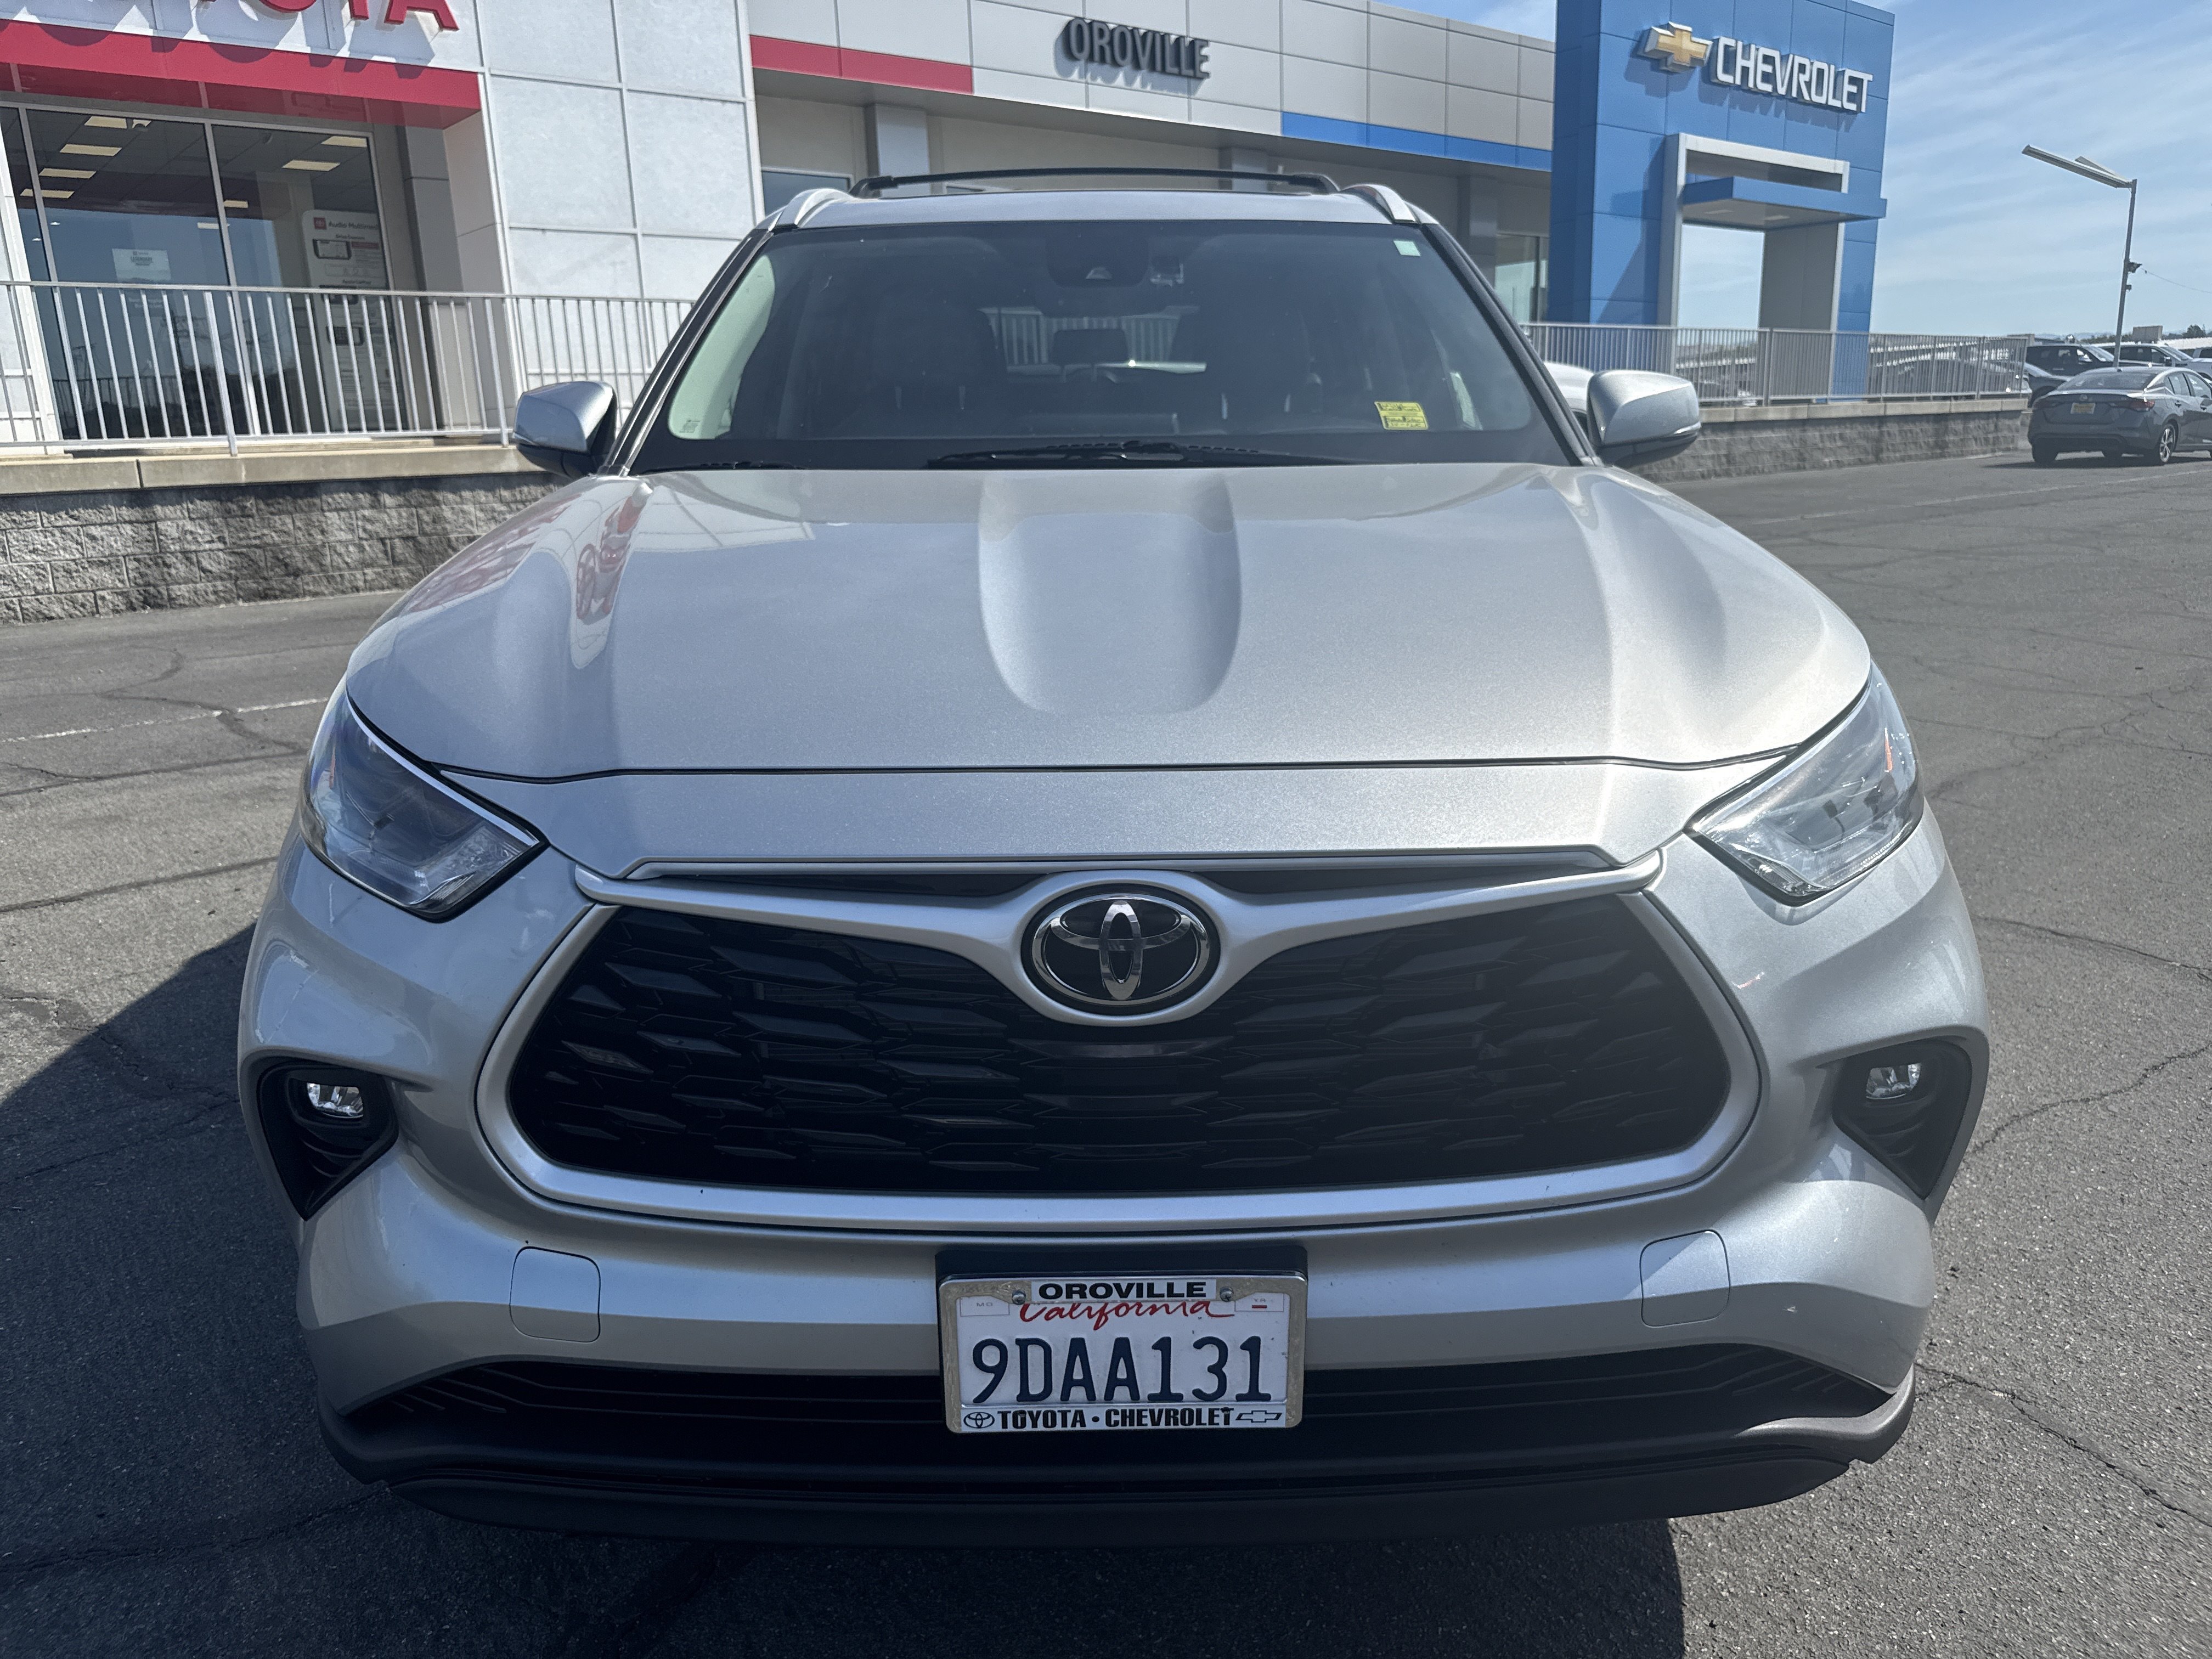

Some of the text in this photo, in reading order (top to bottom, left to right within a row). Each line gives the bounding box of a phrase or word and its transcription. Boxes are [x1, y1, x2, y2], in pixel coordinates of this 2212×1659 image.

[1067, 18, 1210, 79] OROVILLE
[1715, 36, 1874, 113] CHEVROLET
[1039, 1282, 1207, 1299] OROVILLE
[972, 1335, 1272, 1403] 9DAA131
[997, 1407, 1234, 1429] TOYOTA CHEVROLET
